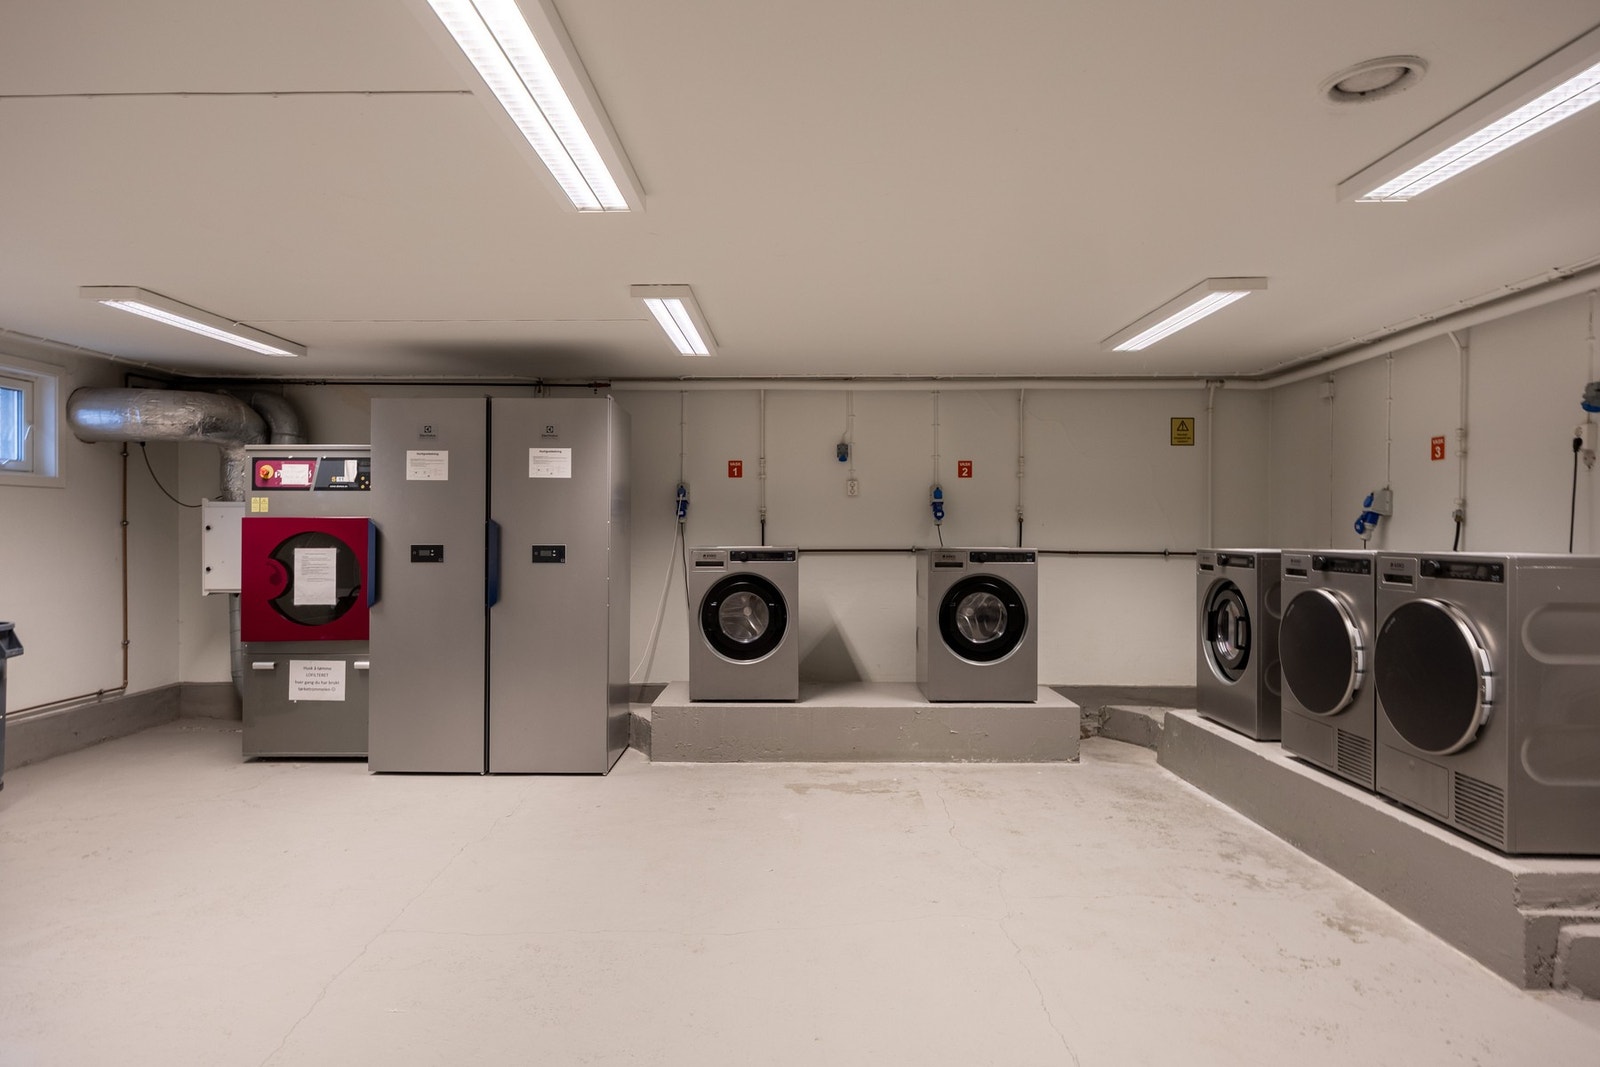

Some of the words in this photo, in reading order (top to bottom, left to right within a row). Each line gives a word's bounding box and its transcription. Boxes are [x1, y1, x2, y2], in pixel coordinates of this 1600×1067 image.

[1435, 446, 1441, 458] 3
[733, 467, 738, 476] 1
[962, 467, 968, 476] 2
